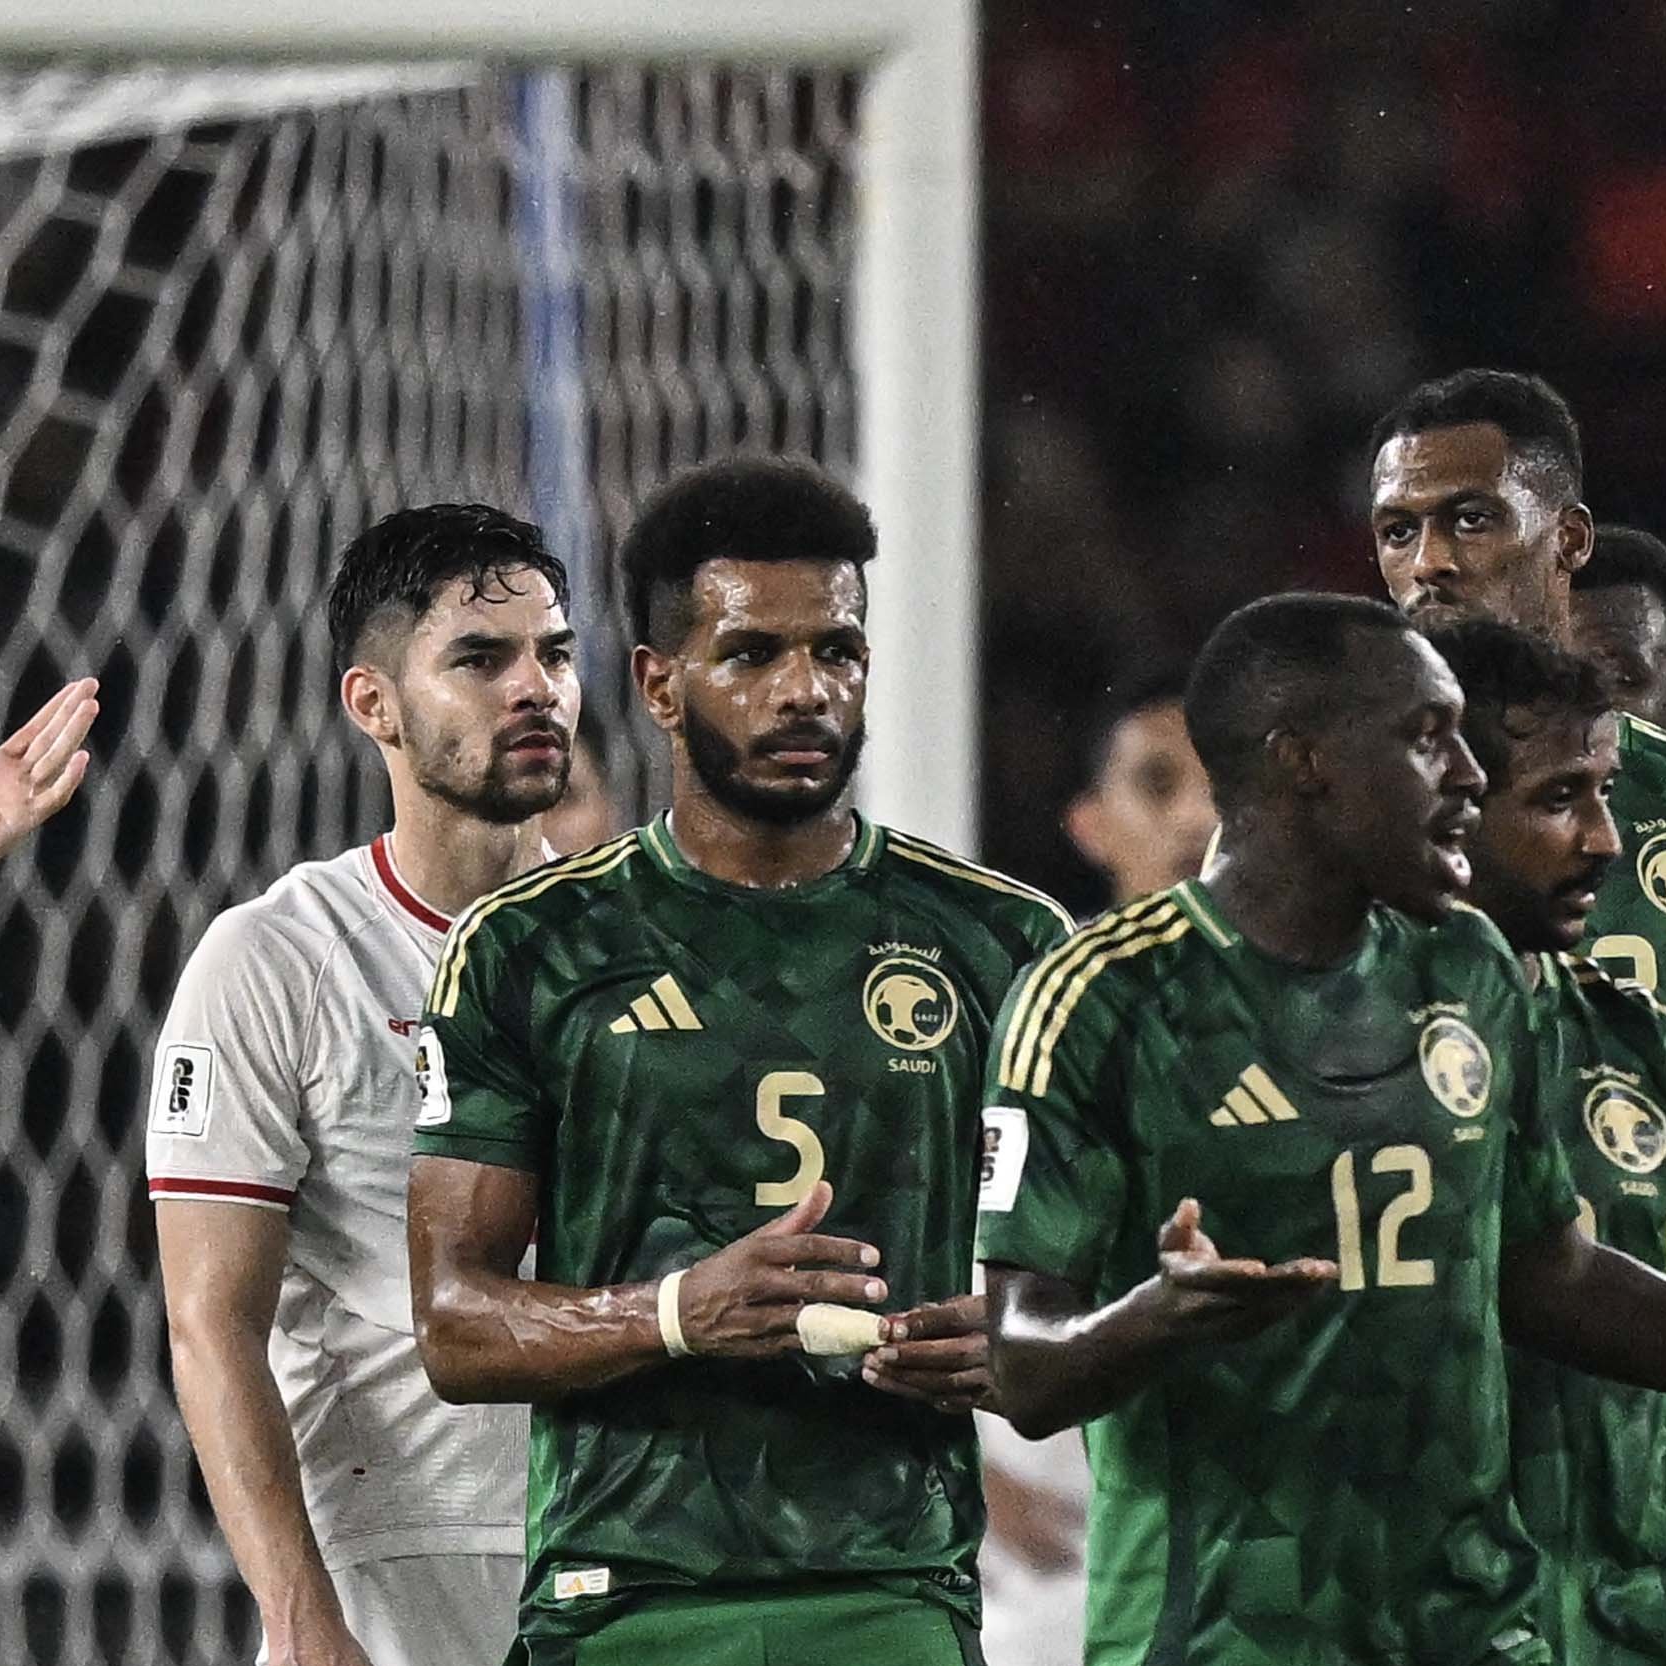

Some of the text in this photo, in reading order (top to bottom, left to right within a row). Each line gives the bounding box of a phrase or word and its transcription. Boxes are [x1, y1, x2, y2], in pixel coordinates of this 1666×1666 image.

[888, 1058, 936, 1074] SAUDI
[755, 1071, 825, 1206] 5
[1331, 1145, 1435, 1291] 12
